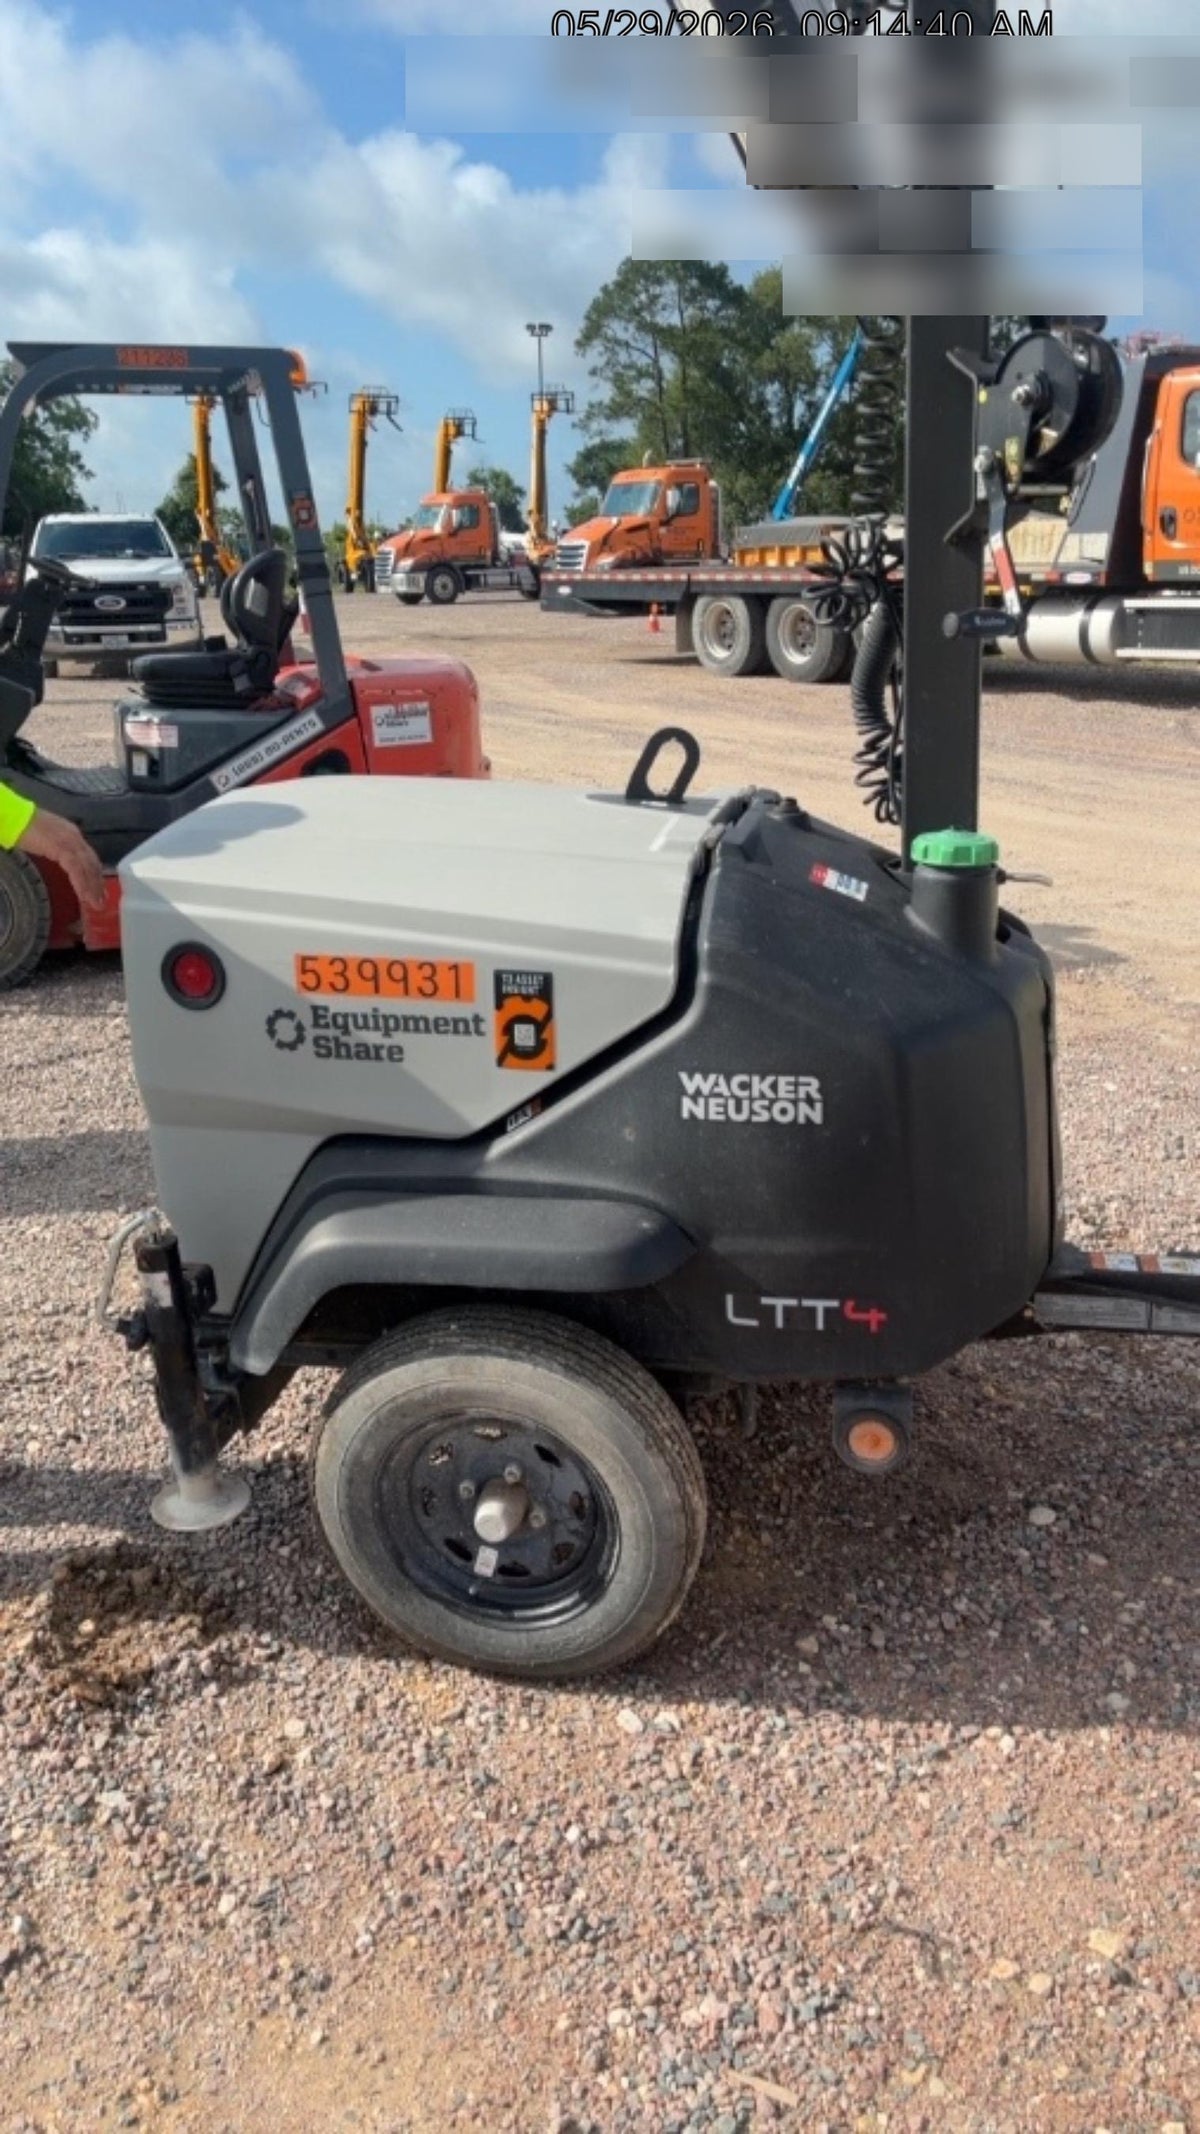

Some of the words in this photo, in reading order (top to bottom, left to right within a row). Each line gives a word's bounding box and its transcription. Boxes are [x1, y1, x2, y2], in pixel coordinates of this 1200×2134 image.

[299, 955, 462, 999] 539931
[310, 1004, 487, 1036] Equipment
[313, 1035, 404, 1063] Share
[678, 1071, 823, 1100] WACKER
[681, 1096, 824, 1125] NEUSON
[725, 1293, 888, 1333] LTT4
